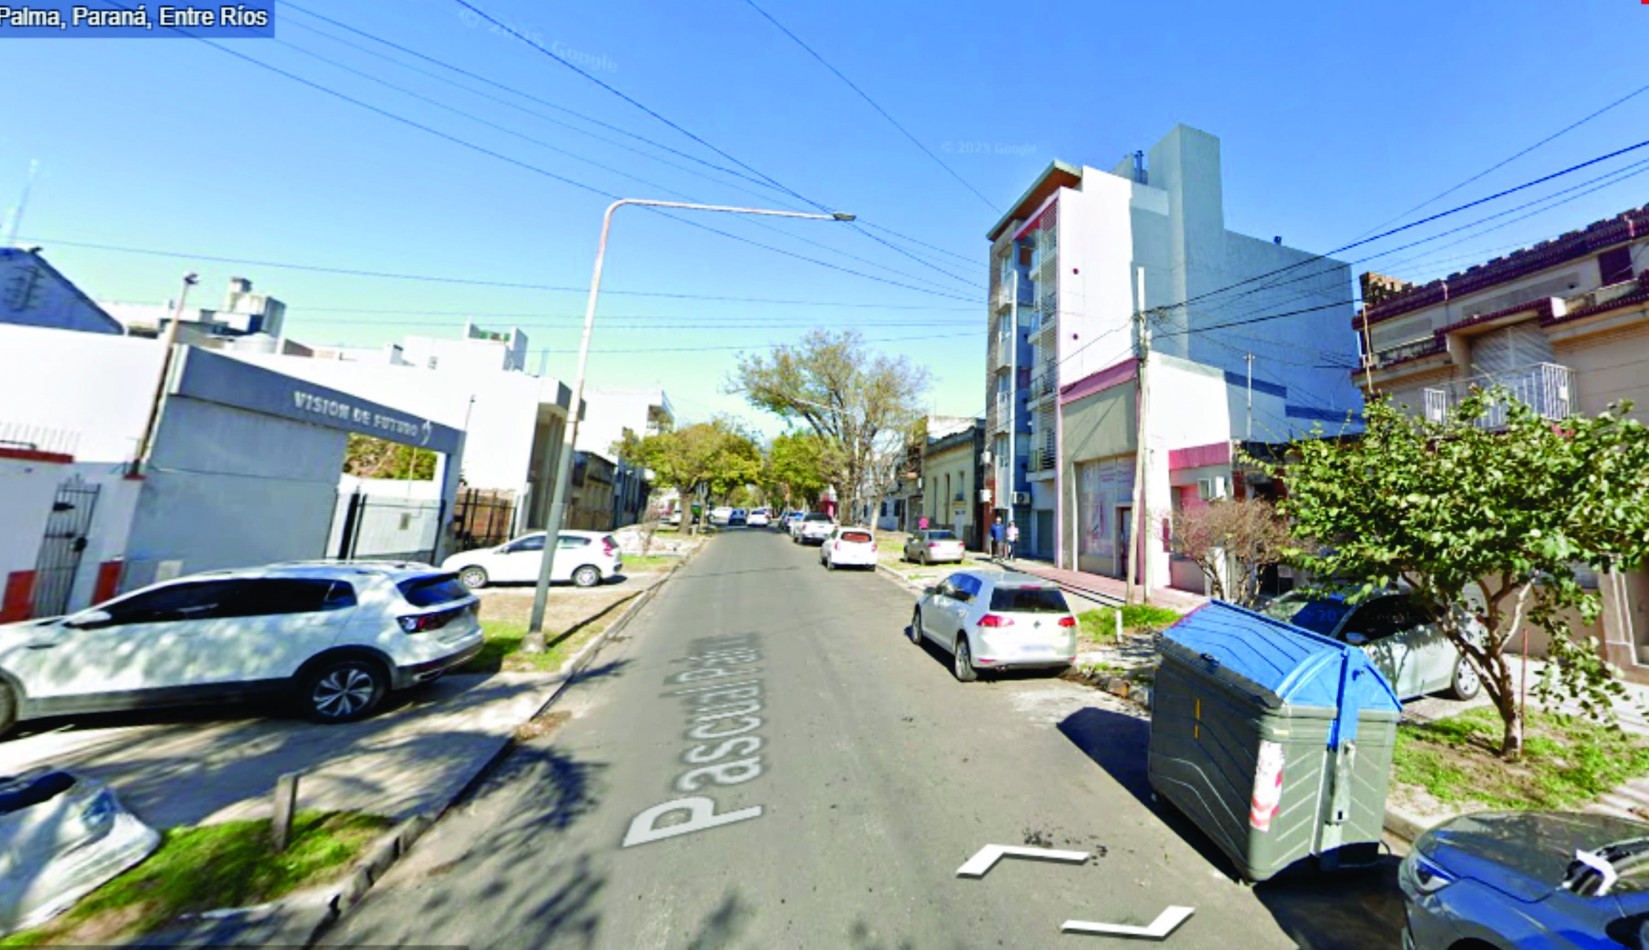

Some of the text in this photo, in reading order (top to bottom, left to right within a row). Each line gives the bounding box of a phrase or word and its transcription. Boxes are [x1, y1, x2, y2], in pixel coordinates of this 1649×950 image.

[295, 391, 418, 434] VISION DE FUTURO
